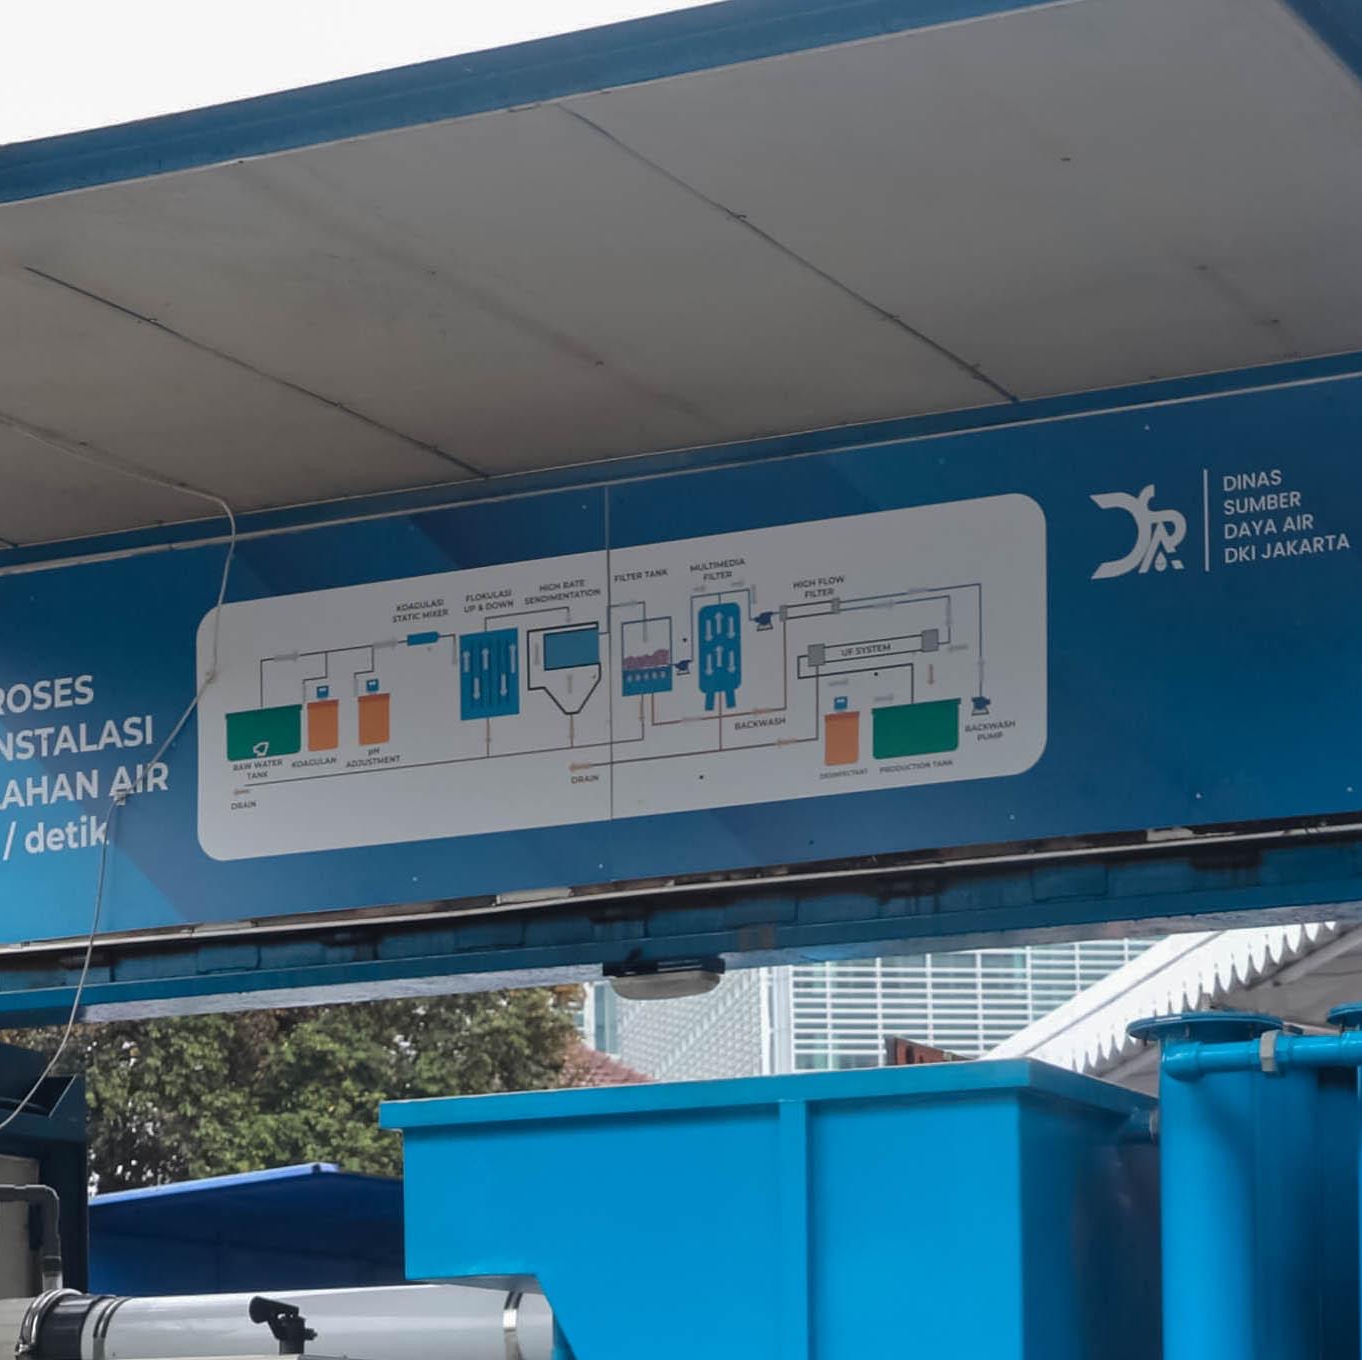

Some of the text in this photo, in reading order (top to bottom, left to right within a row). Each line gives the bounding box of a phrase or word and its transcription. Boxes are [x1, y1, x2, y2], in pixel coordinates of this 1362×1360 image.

[1223, 469, 1283, 491] DINAS
[1224, 491, 1301, 516] SUMBER
[1224, 514, 1314, 540] DAYA AIR
[1224, 533, 1350, 564] DKI JAKARTA
[690, 558, 746, 572] MULTIMEDIA
[614, 568, 668, 583] FILTER TANK
[703, 571, 733, 581] FILTER
[818, 575, 845, 586] FLOW
[804, 588, 834, 599] FILTER
[486, 600, 514, 611] DOWN
[392, 608, 449, 623] STATIC MIXER
[855, 643, 891, 655] SYSTEM
[734, 717, 786, 731] BACKWASH
[254, 759, 283, 770] WATER
[346, 755, 401, 768] ADJUSTMENT
[110, 762, 169, 797] AIR
[247, 771, 269, 780] TANK
[570, 775, 599, 784] DRAIN
[2, 821, 17, 861] /
[25, 815, 110, 854] detik
